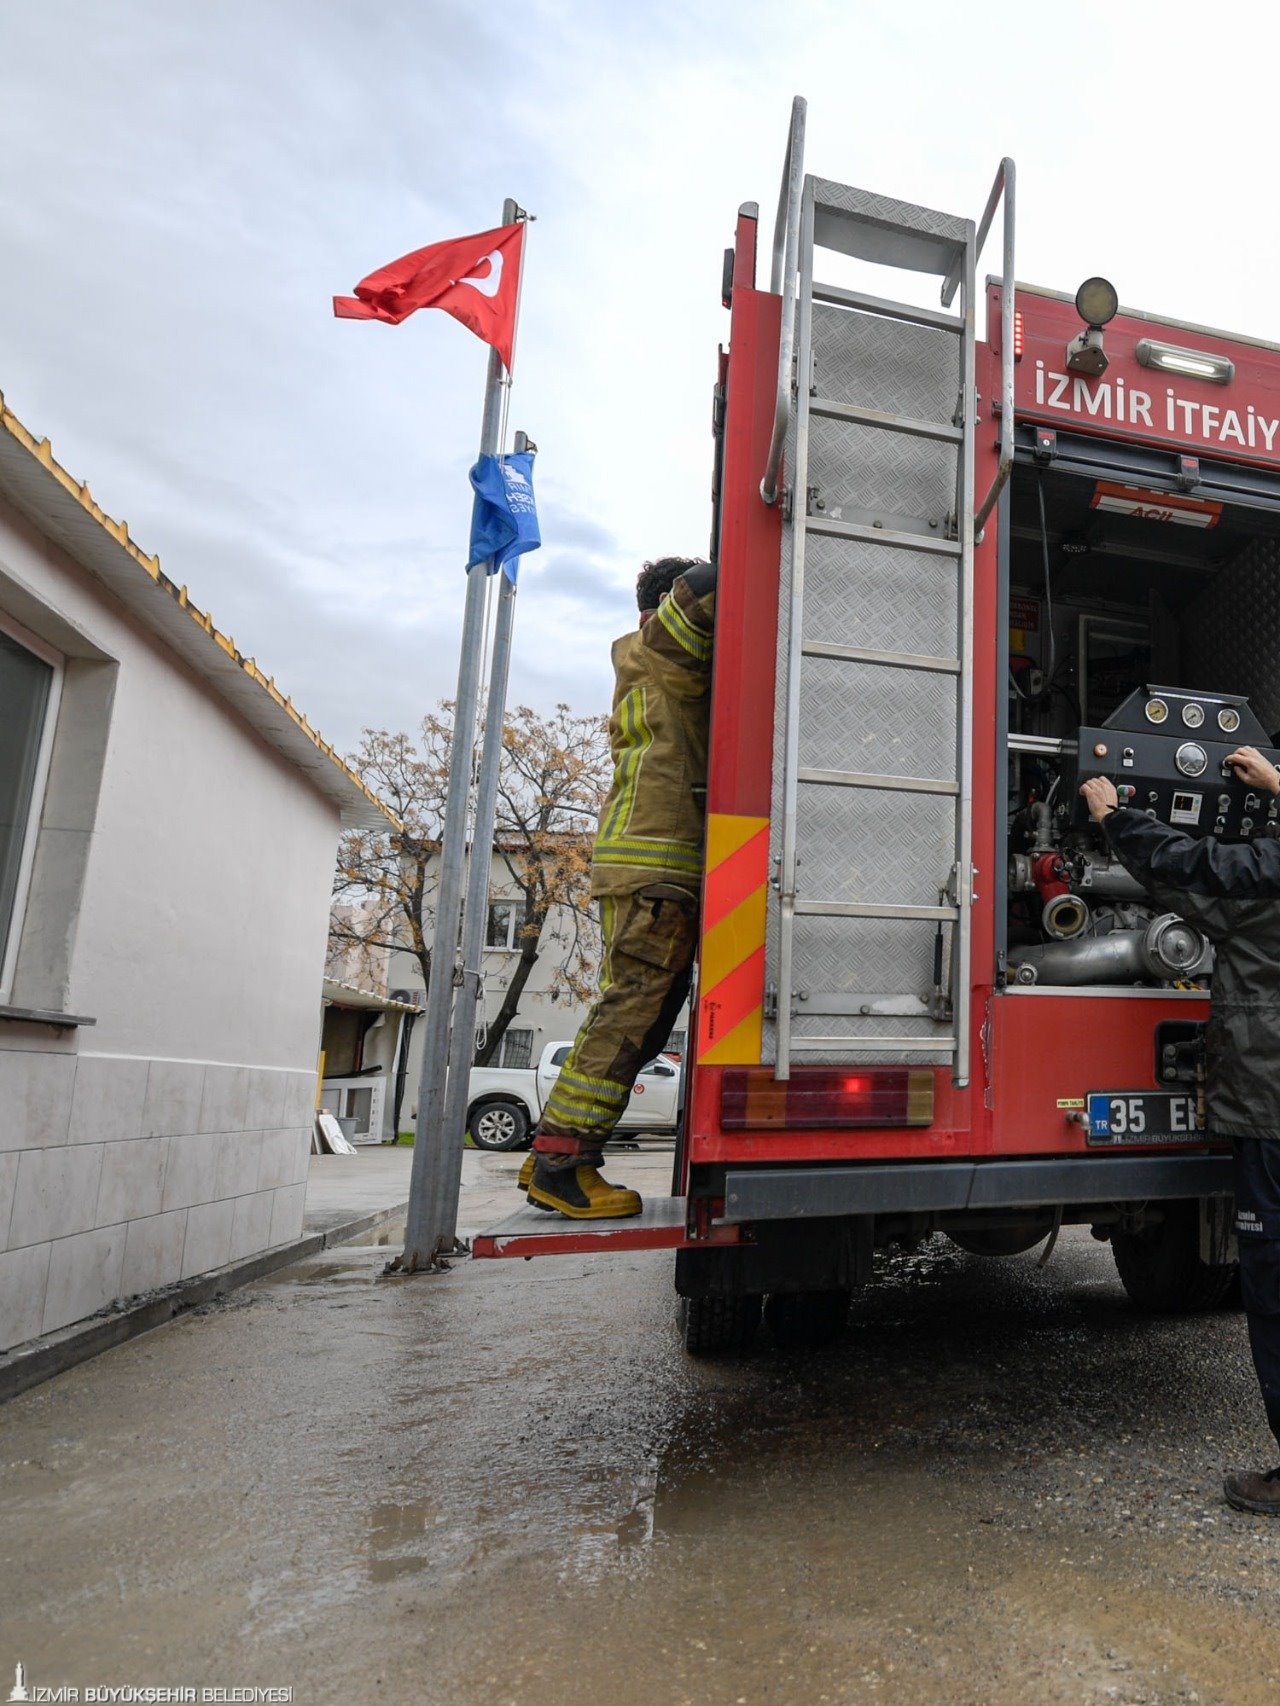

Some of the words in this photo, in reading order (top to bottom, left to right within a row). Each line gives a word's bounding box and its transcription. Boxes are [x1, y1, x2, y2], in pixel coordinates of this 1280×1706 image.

[1035, 360, 1153, 426] İZMİR
[1095, 1120, 1108, 1131] TR
[1110, 1099, 1146, 1133] 35
